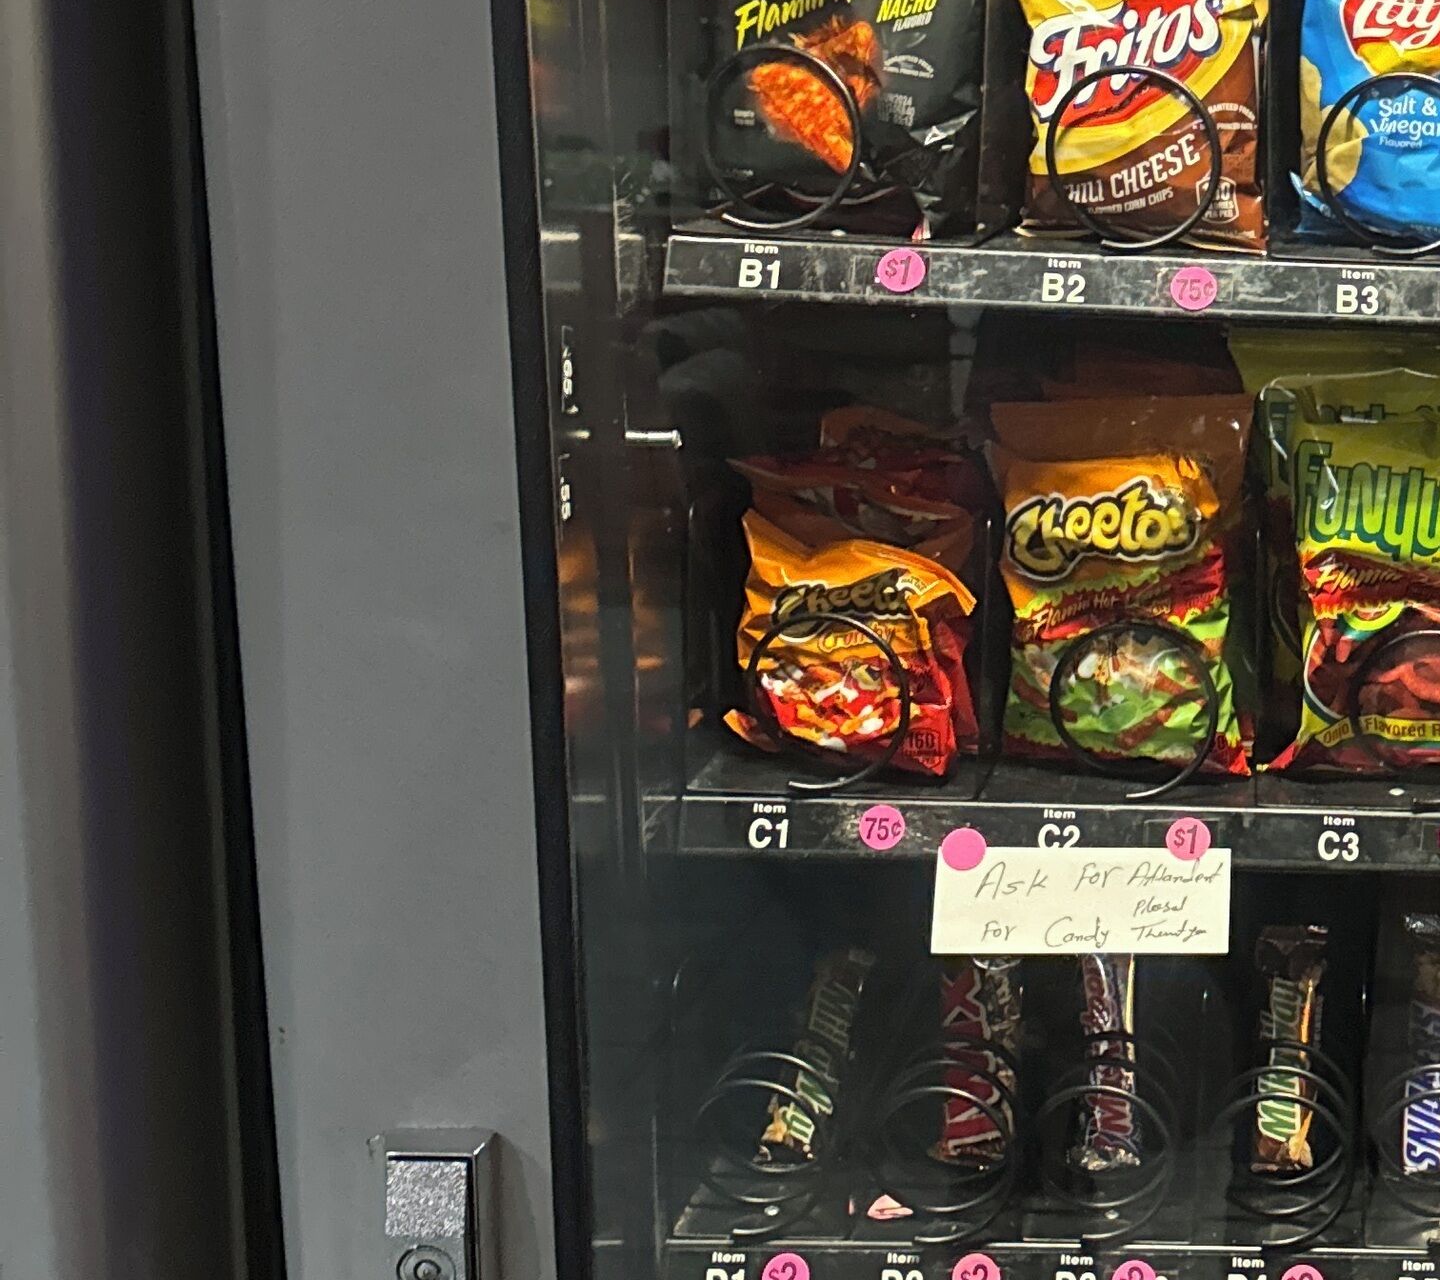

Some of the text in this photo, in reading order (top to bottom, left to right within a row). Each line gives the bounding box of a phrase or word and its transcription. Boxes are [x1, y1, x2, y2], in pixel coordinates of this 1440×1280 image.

[1378, 96, 1438, 118] Salt &
[1110, 133, 1201, 200] CHEESE
[1124, 196, 1147, 212] CORN
[1148, 186, 1175, 206] CHIPS
[744, 243, 779, 254] Item
[738, 258, 781, 289] B1
[885, 256, 912, 285] $1
[1048, 258, 1082, 269] Item
[1341, 269, 1375, 280] Item
[1041, 272, 1087, 303] B2
[1176, 278, 1215, 301] 75¢
[1335, 284, 1380, 315] B3
[1364, 718, 1426, 738] Flavored
[753, 803, 786, 814] Item
[1043, 808, 1076, 819] Item
[865, 817, 901, 841] 75¢
[1323, 815, 1355, 826] Item
[748, 817, 789, 849] C1
[1037, 823, 1081, 848] C2
[1173, 824, 1198, 854] $1
[1317, 830, 1360, 861] C3
[975, 861, 1049, 900] Ask
[1044, 916, 1110, 948] Candy
[711, 1251, 745, 1263] Item
[887, 1252, 919, 1264] Item
[1060, 1254, 1093, 1266] Item
[1231, 1256, 1265, 1269] Item
[1402, 1260, 1435, 1272] Item
